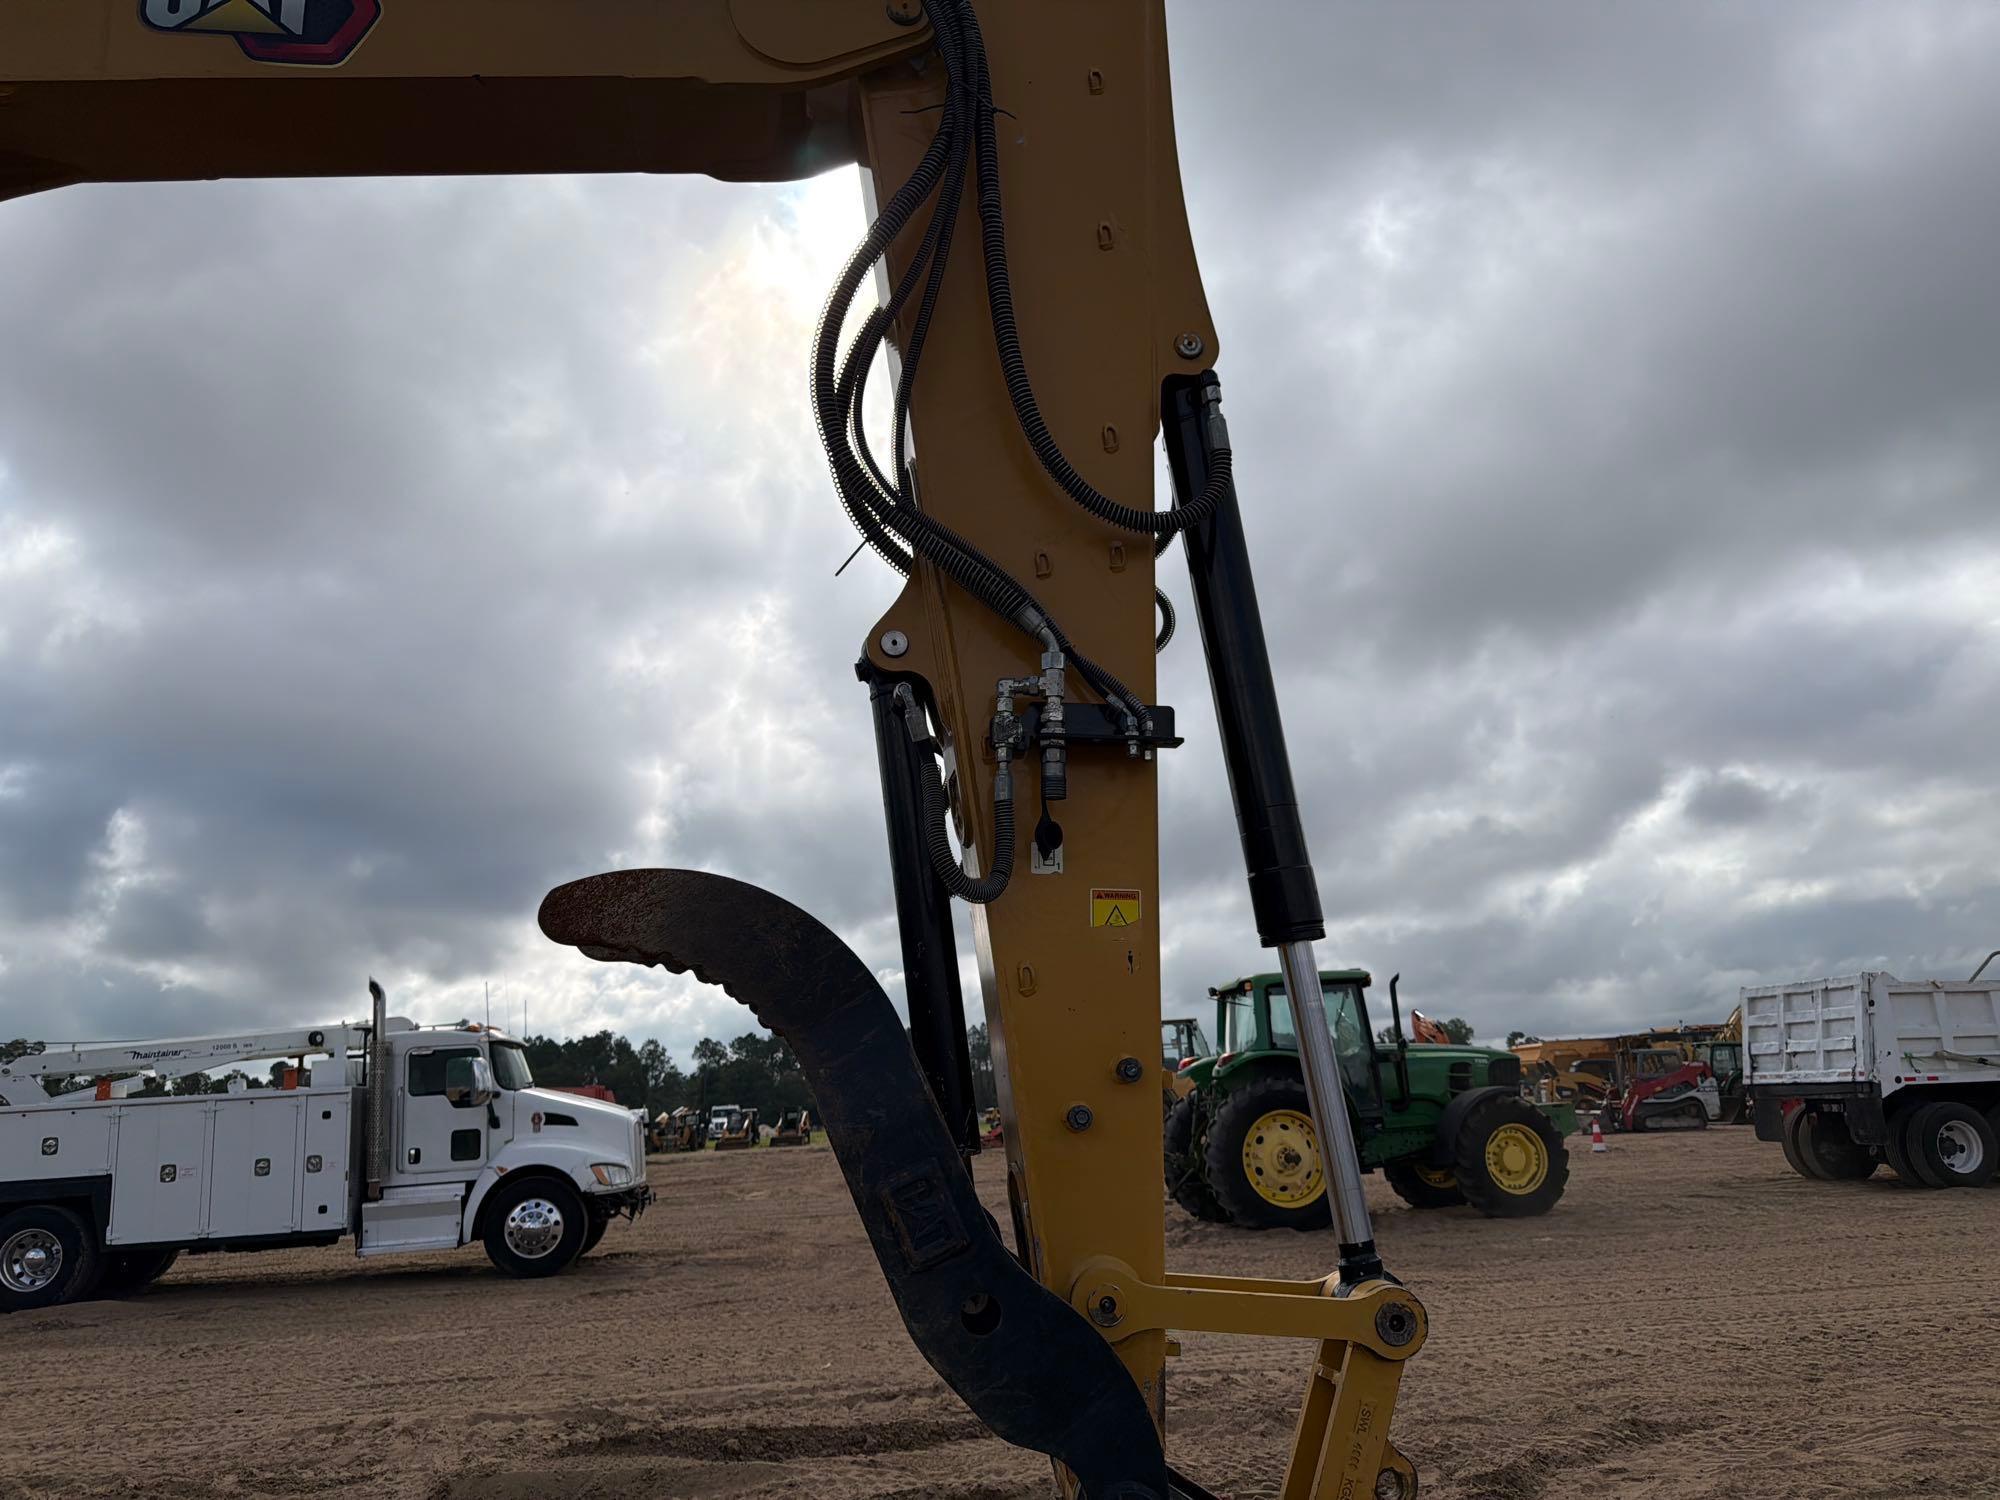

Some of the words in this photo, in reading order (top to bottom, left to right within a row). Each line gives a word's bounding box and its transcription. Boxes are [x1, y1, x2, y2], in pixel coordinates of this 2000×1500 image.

[1103, 892, 1137, 900] WARNING
[130, 1048, 183, 1060] Maintainer
[1357, 1407, 1372, 1434] SWL
